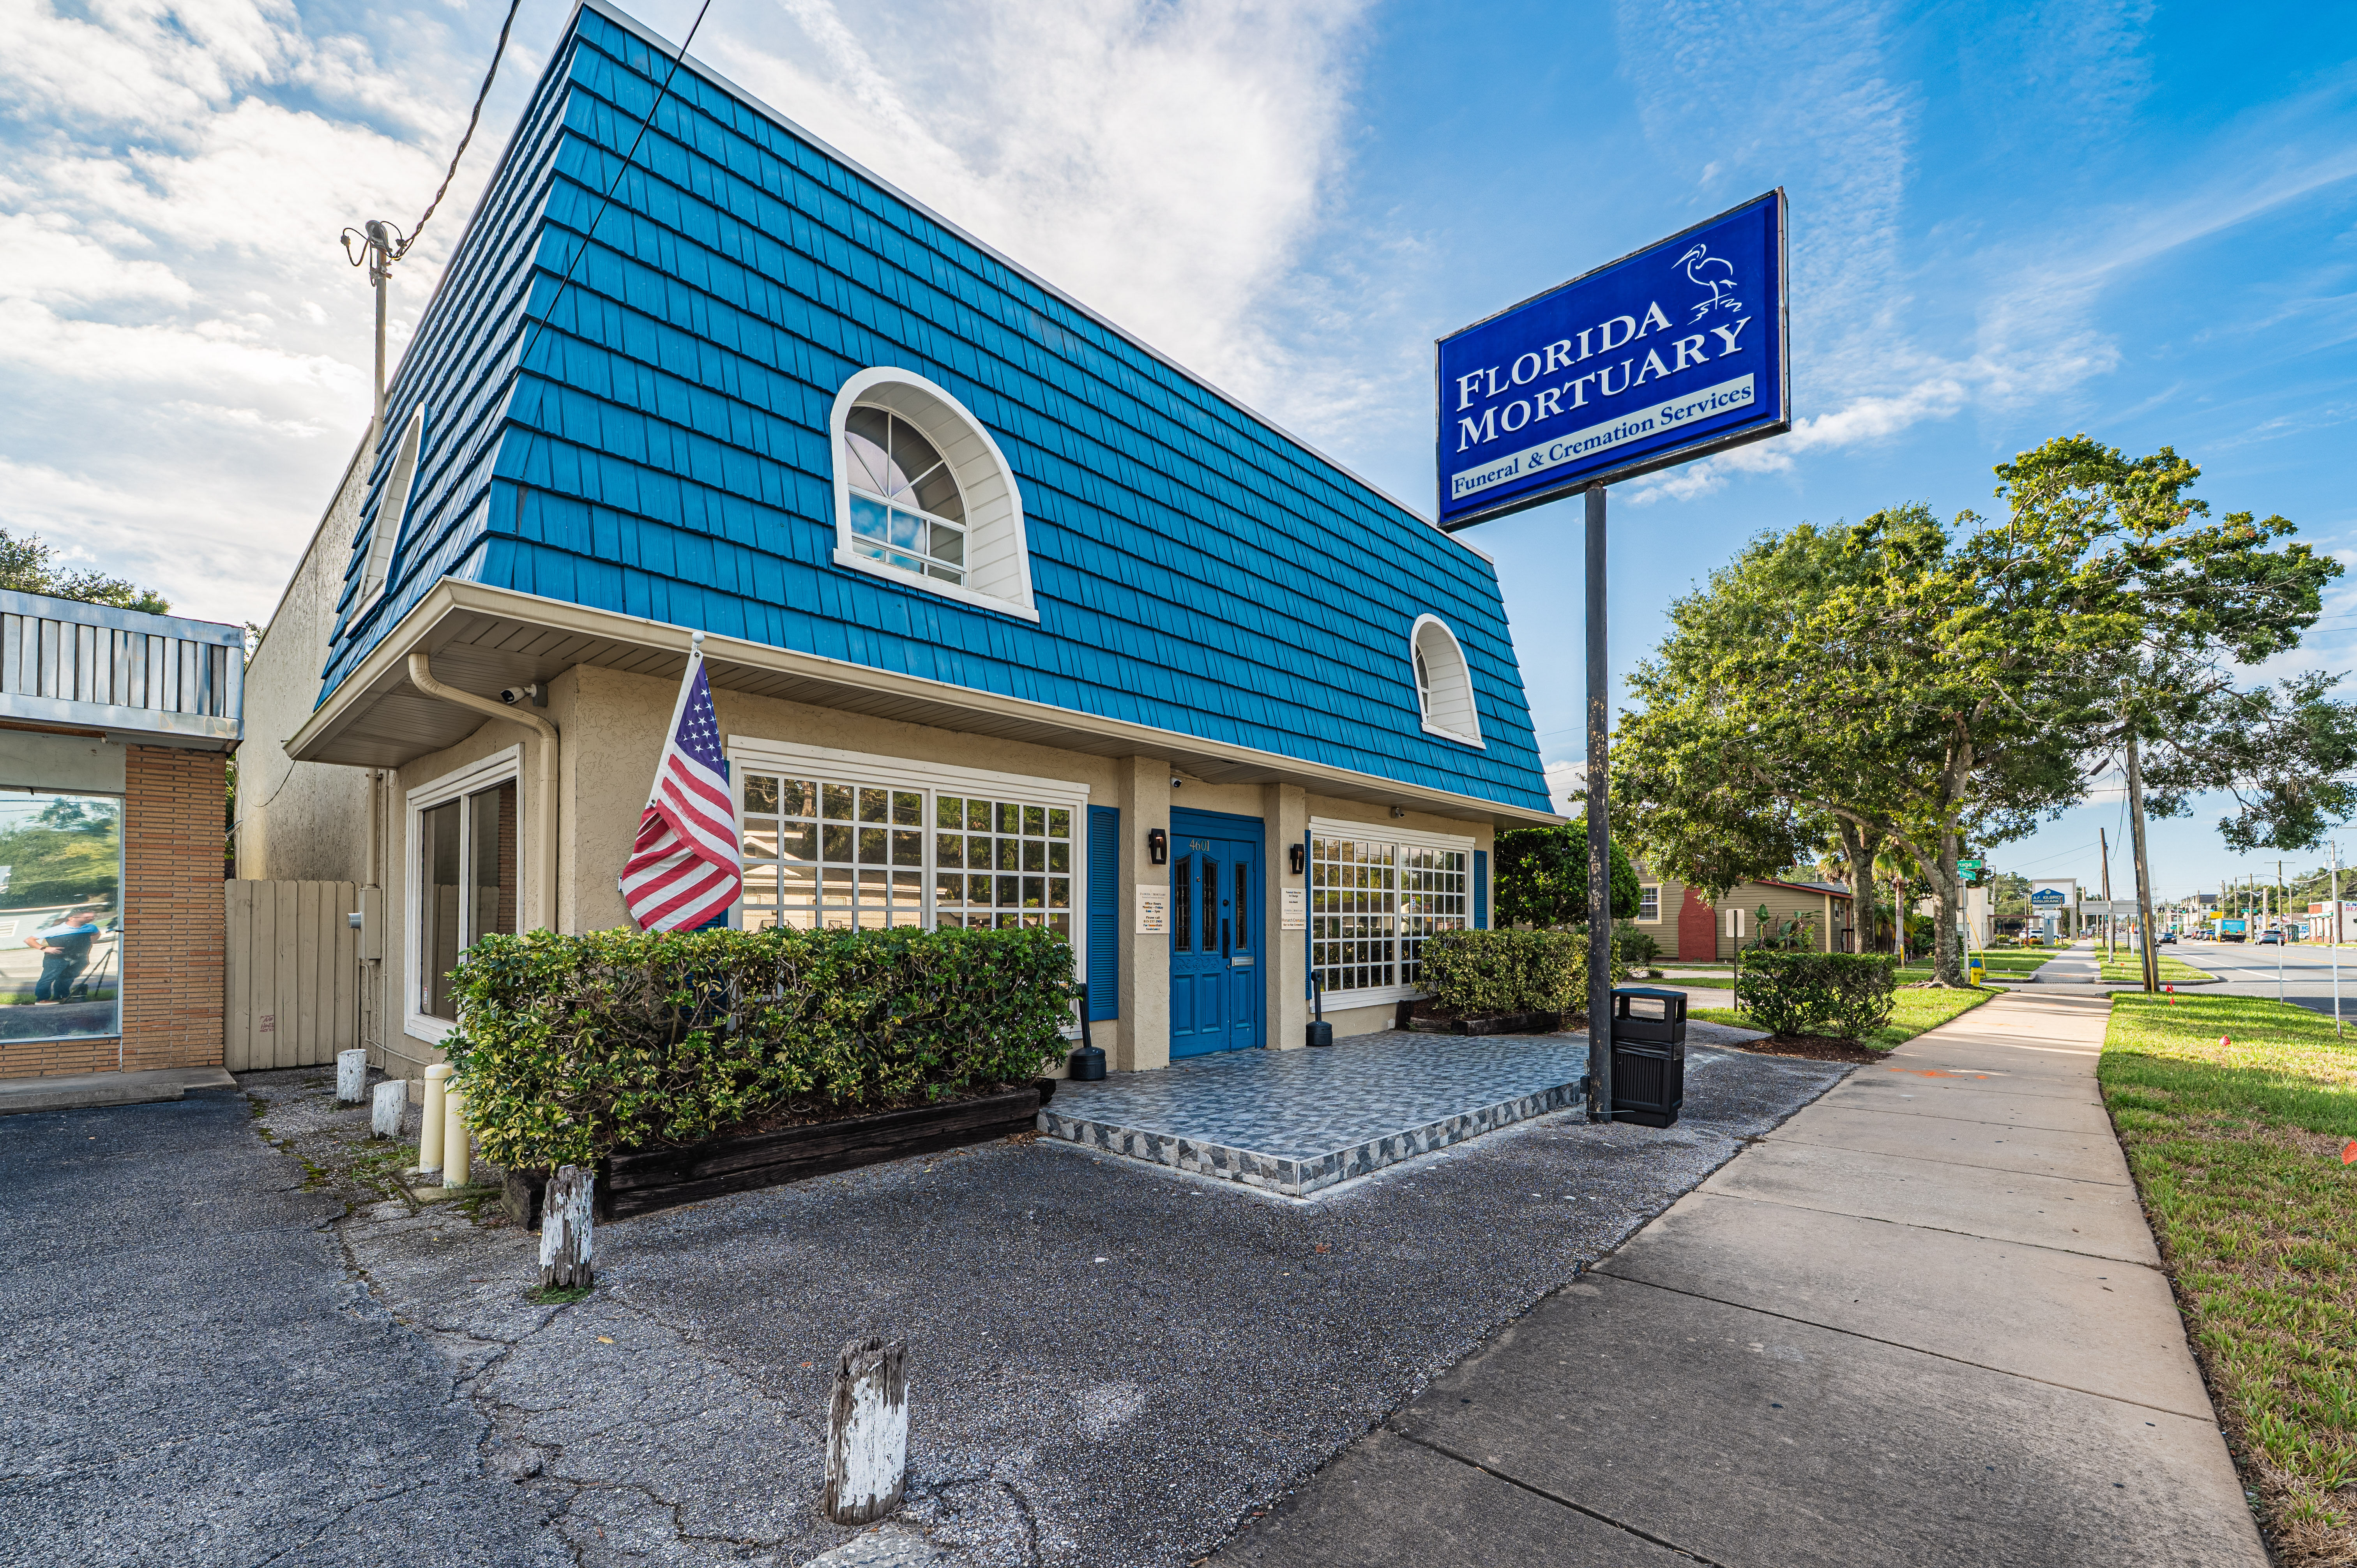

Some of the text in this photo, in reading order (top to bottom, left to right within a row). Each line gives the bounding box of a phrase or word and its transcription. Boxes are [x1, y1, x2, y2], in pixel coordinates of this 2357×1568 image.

[1456, 301, 1672, 412] FLORIDA
[1456, 316, 1751, 453] MORTUARY
[1454, 384, 1752, 495] Funeral & Cremation Services
[1189, 839, 1210, 851] 4601
